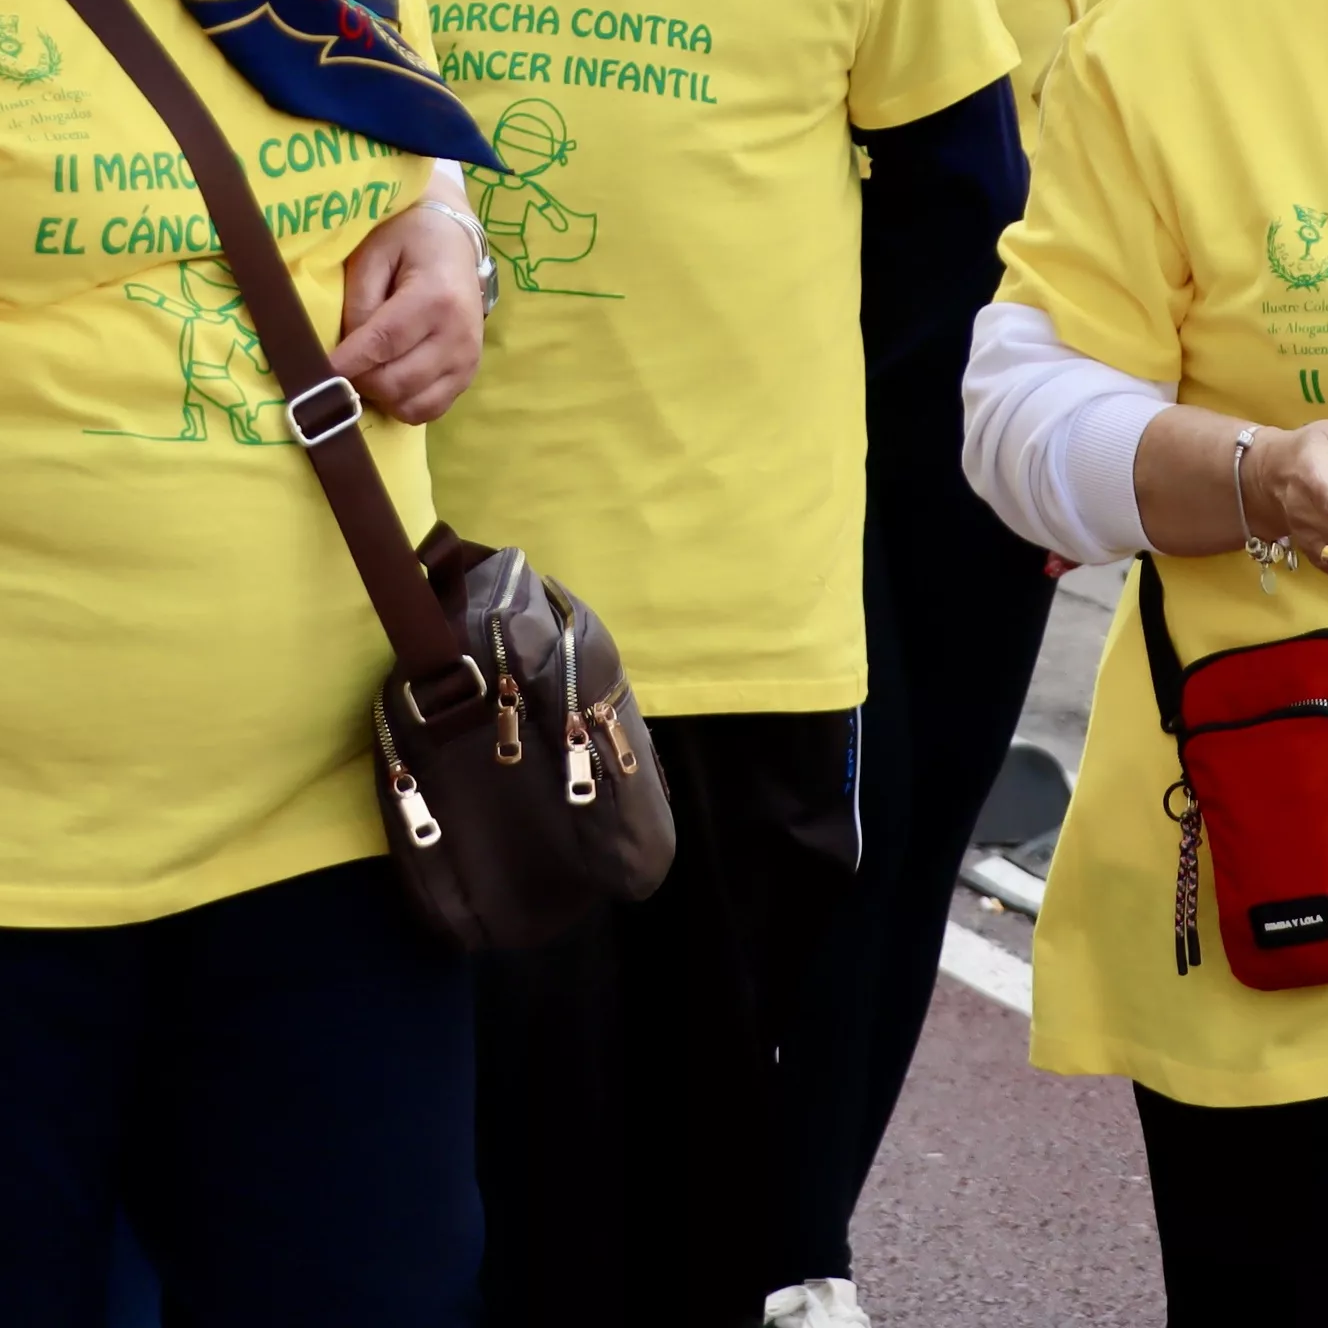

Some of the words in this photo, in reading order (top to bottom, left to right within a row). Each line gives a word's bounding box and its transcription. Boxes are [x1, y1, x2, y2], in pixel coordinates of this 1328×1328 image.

[571, 8, 713, 54] CONTRA
[437, 42, 551, 83] ÁNCER
[563, 56, 719, 104] INFANTIL
[55, 154, 79, 193] II
[35, 217, 85, 254] EL
[1300, 369, 1325, 403] II
[1291, 918, 1299, 927] Y
[1299, 914, 1324, 926] LOLA
